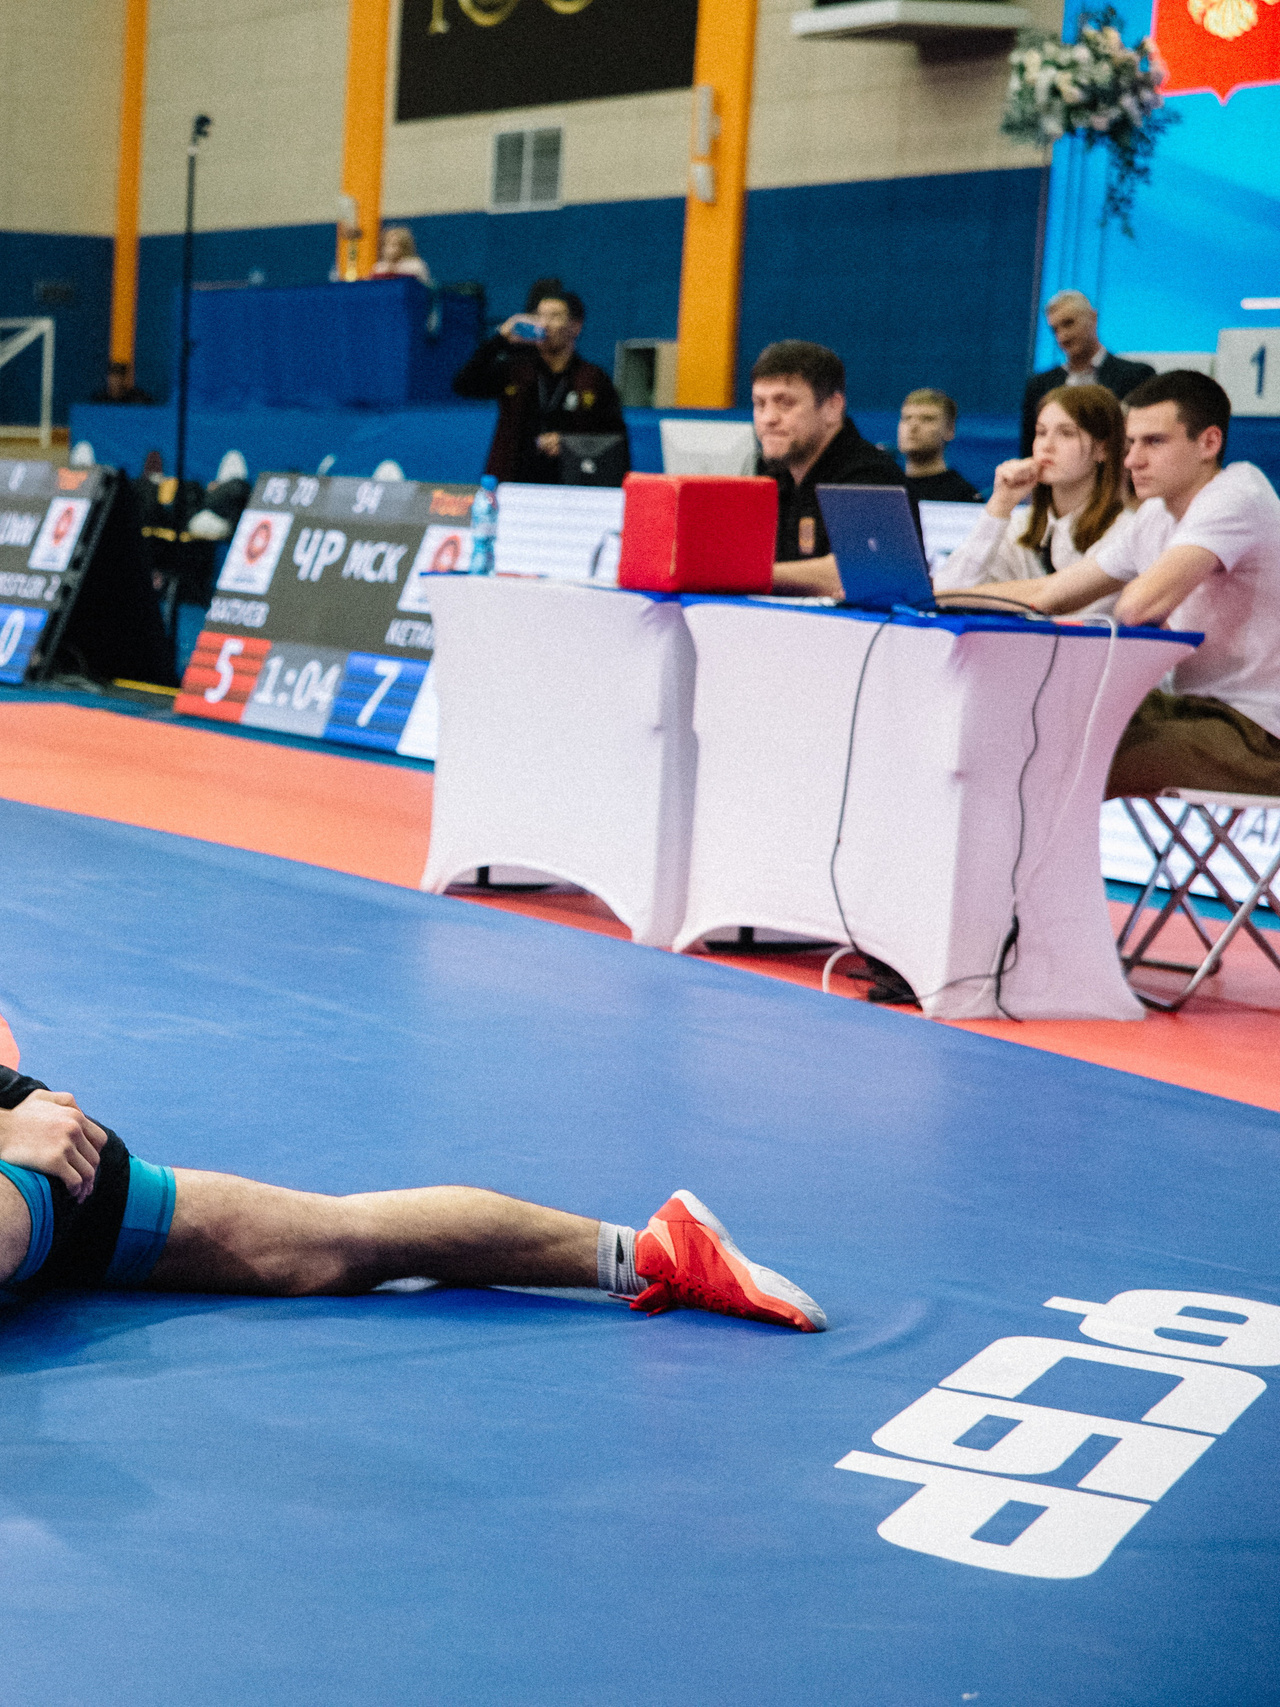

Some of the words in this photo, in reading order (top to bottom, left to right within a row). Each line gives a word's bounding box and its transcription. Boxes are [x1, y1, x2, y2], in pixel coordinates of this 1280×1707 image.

[1250, 345, 1267, 397] 1
[292, 527, 347, 582] ЧР
[204, 639, 244, 703] 5
[254, 655, 341, 712] 1:04
[356, 660, 403, 727] 7
